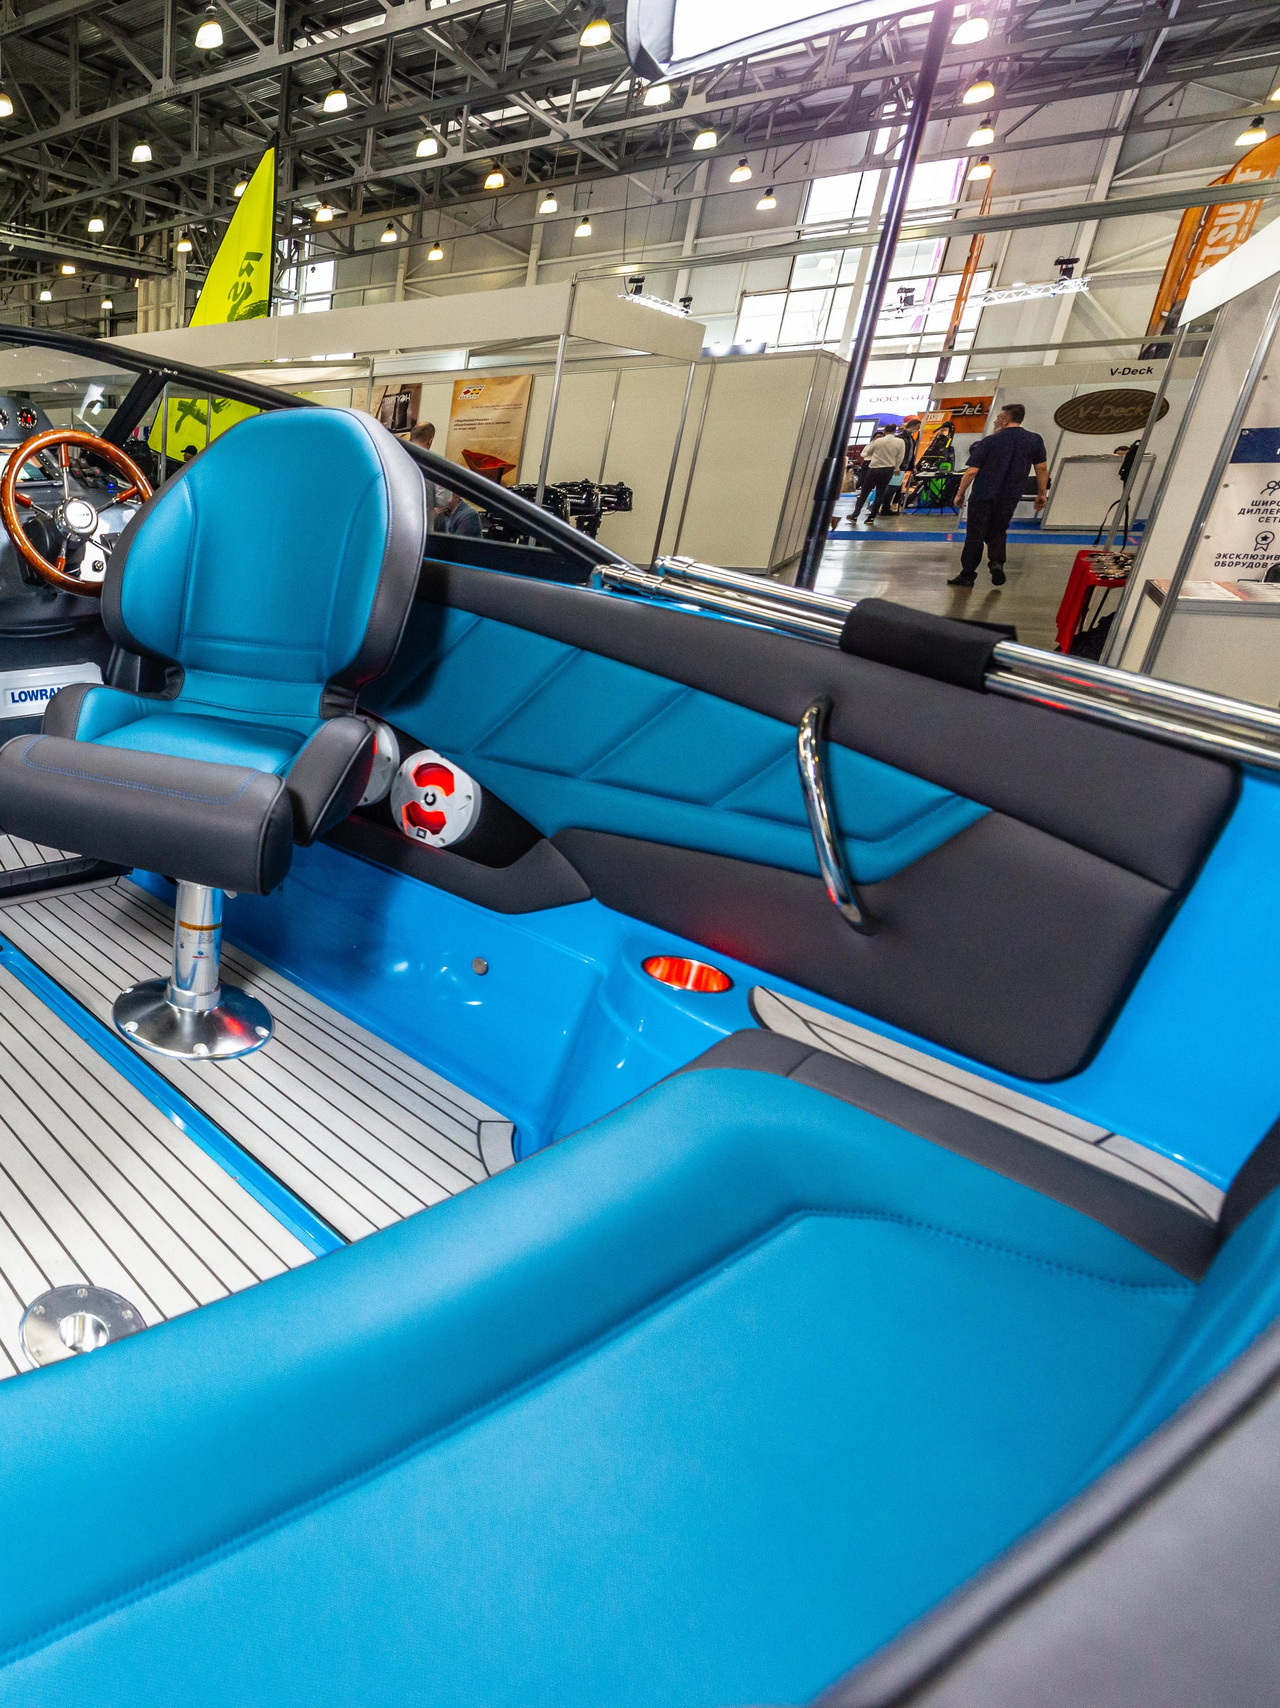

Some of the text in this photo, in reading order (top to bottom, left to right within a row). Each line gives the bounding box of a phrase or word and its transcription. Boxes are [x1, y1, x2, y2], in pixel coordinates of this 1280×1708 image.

[1110, 366, 1154, 377] V-Deck
[1078, 403, 1147, 419] V-Deck
[1214, 561, 1269, 569] ОБОРУДОВ
[10, 687, 62, 704] LOWRA
